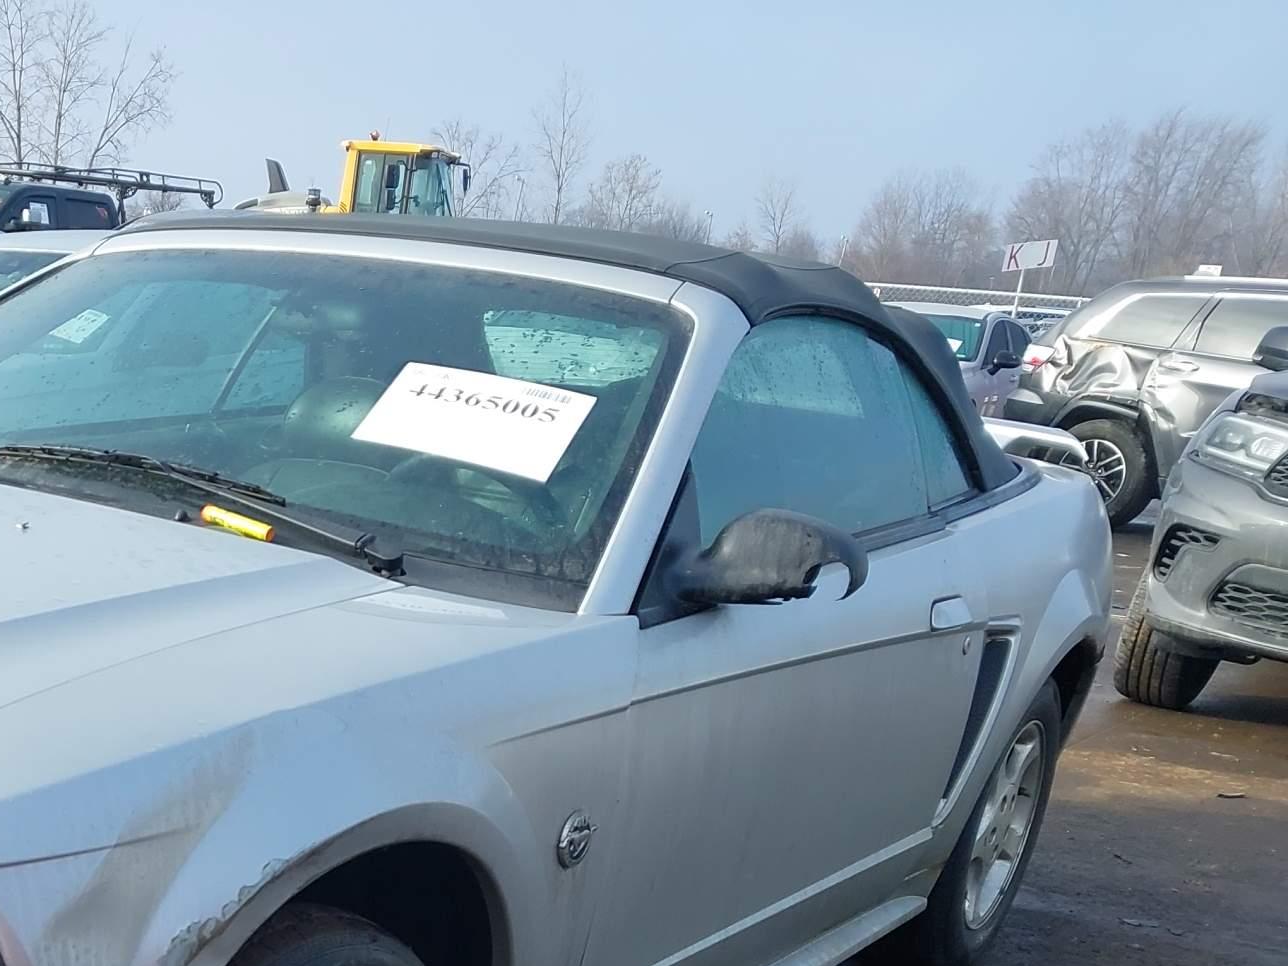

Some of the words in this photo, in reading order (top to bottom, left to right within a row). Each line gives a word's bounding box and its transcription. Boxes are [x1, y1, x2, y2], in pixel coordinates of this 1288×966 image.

[1007, 244, 1024, 269] K
[1036, 241, 1050, 266] J
[409, 383, 561, 423] 44365005
